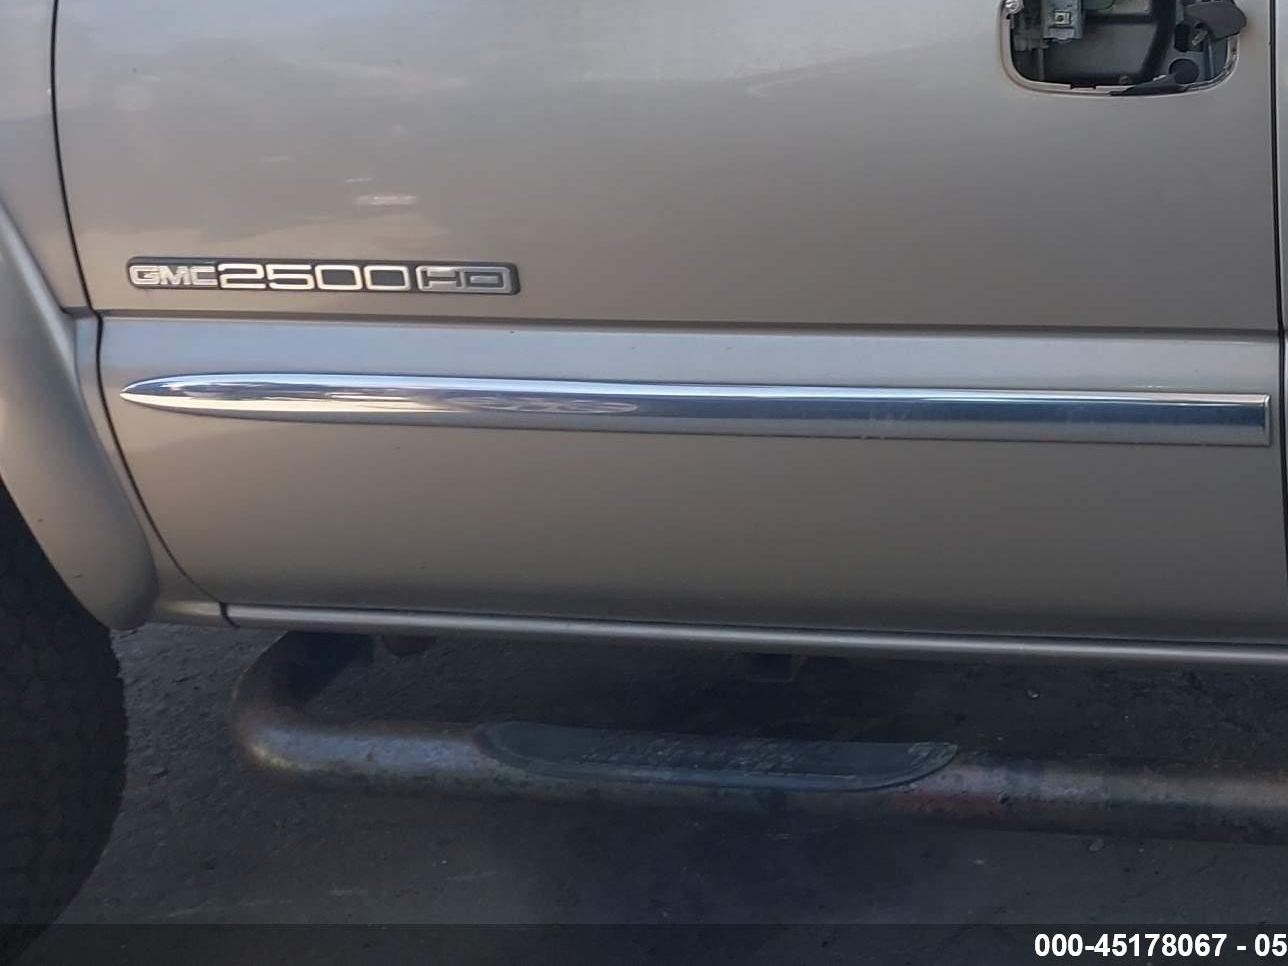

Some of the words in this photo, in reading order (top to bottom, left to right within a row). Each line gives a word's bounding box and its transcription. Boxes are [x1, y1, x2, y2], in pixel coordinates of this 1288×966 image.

[128, 264, 218, 289] GMC
[218, 263, 411, 292] 2500
[415, 265, 514, 294] HD
